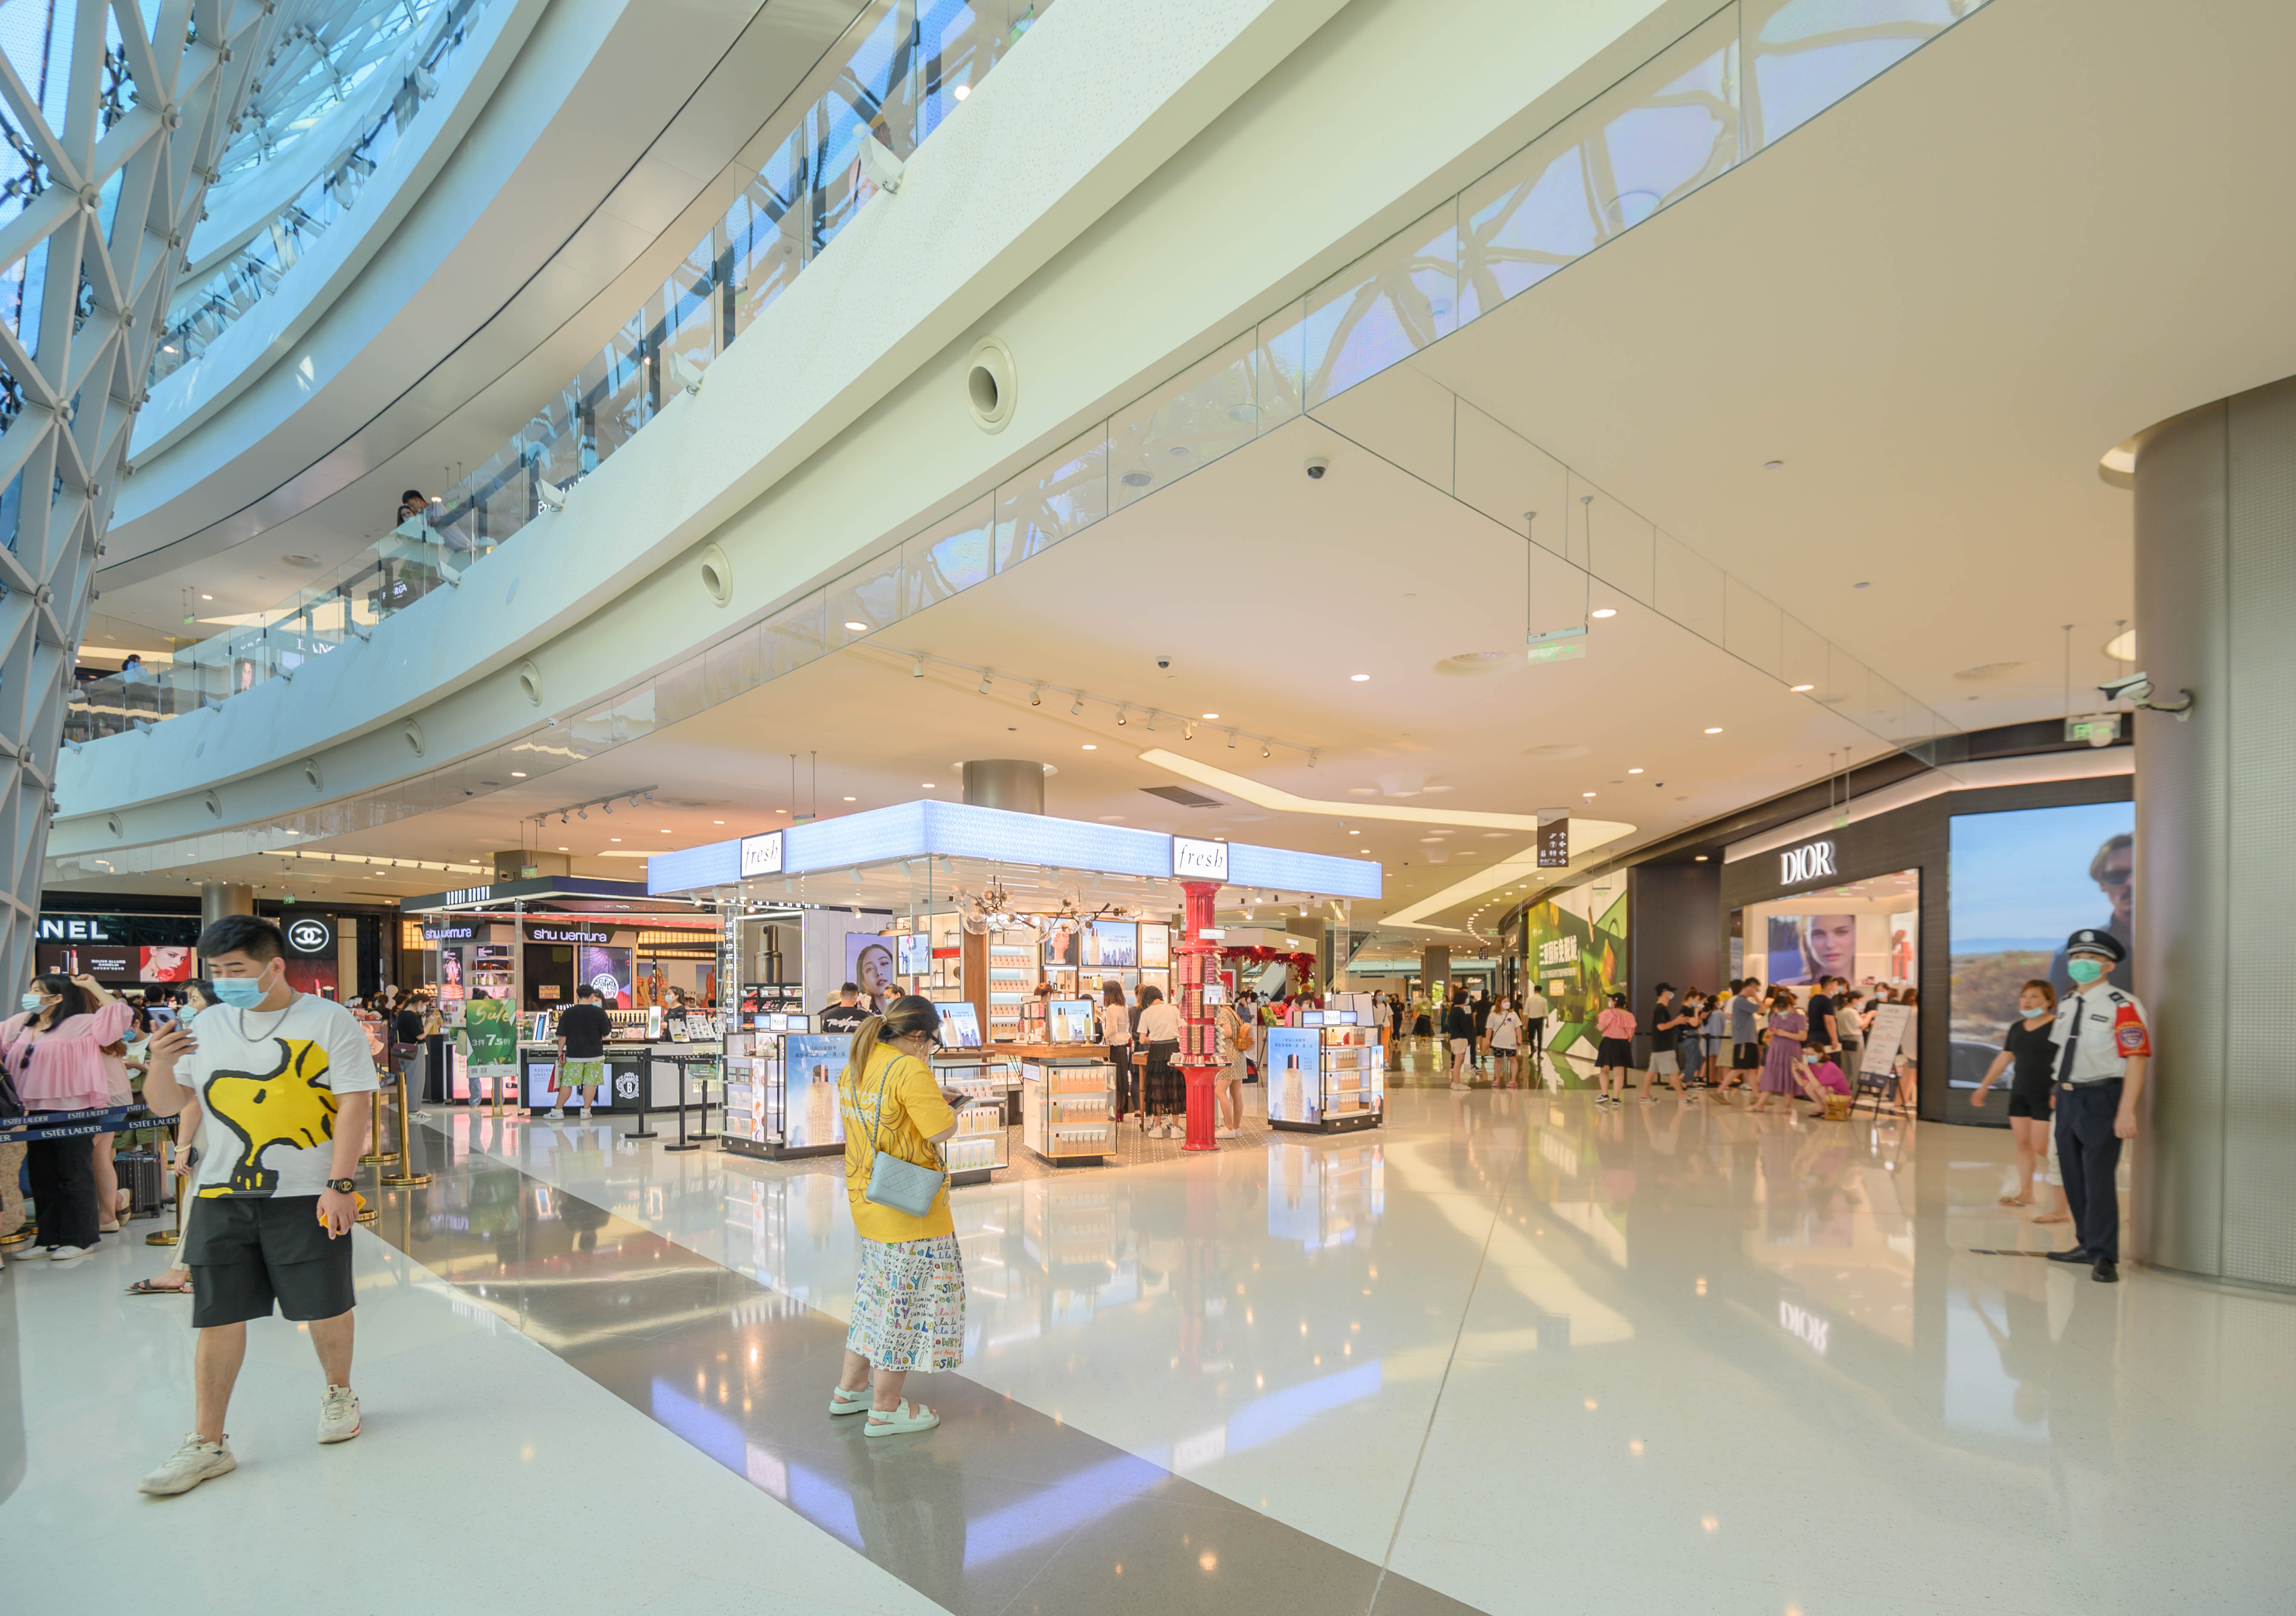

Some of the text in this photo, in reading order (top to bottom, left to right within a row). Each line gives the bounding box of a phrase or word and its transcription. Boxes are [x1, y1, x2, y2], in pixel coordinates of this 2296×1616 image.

[745, 840, 777, 870] fresh
[1180, 845, 1222, 868] fresh
[1780, 842, 1833, 885] DIOR
[426, 928, 471, 939] shu uemura
[534, 929, 607, 942] shu uemura
[471, 1004, 510, 1025] Sale
[627, 1082, 632, 1093] B
[86, 1109, 109, 1117] LAUDER
[23, 1116, 48, 1124] LAUDER
[68, 1125, 102, 1135] LAUDER
